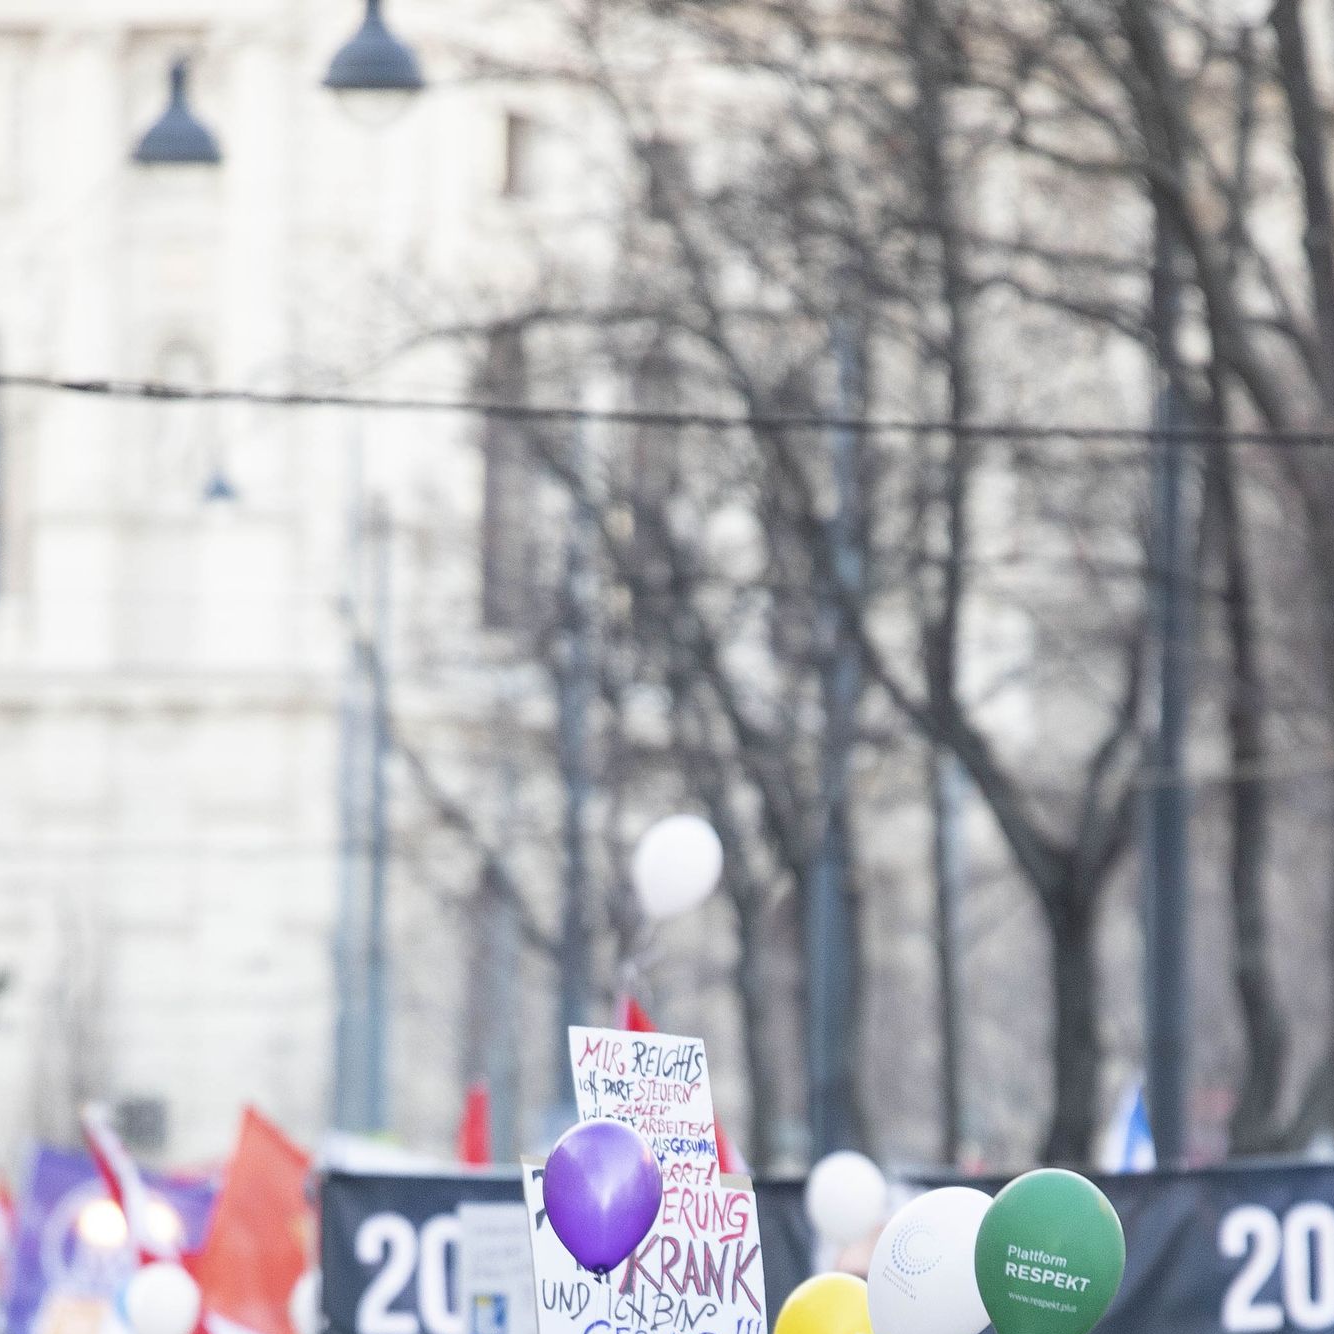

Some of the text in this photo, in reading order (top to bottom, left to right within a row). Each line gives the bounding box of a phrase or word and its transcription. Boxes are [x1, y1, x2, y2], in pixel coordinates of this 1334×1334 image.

[578, 1036, 626, 1075] MIR
[602, 1078, 634, 1100] DARF
[634, 1078, 700, 1103] STEUERN
[639, 1120, 716, 1137] ARBEITEN
[662, 1187, 751, 1243] ERUNG
[1008, 1244, 1068, 1268] Plattform
[618, 1234, 763, 1314] KRANK
[1005, 1262, 1091, 1292] RESPEKT
[542, 1279, 717, 1332] UND ICH BIN
